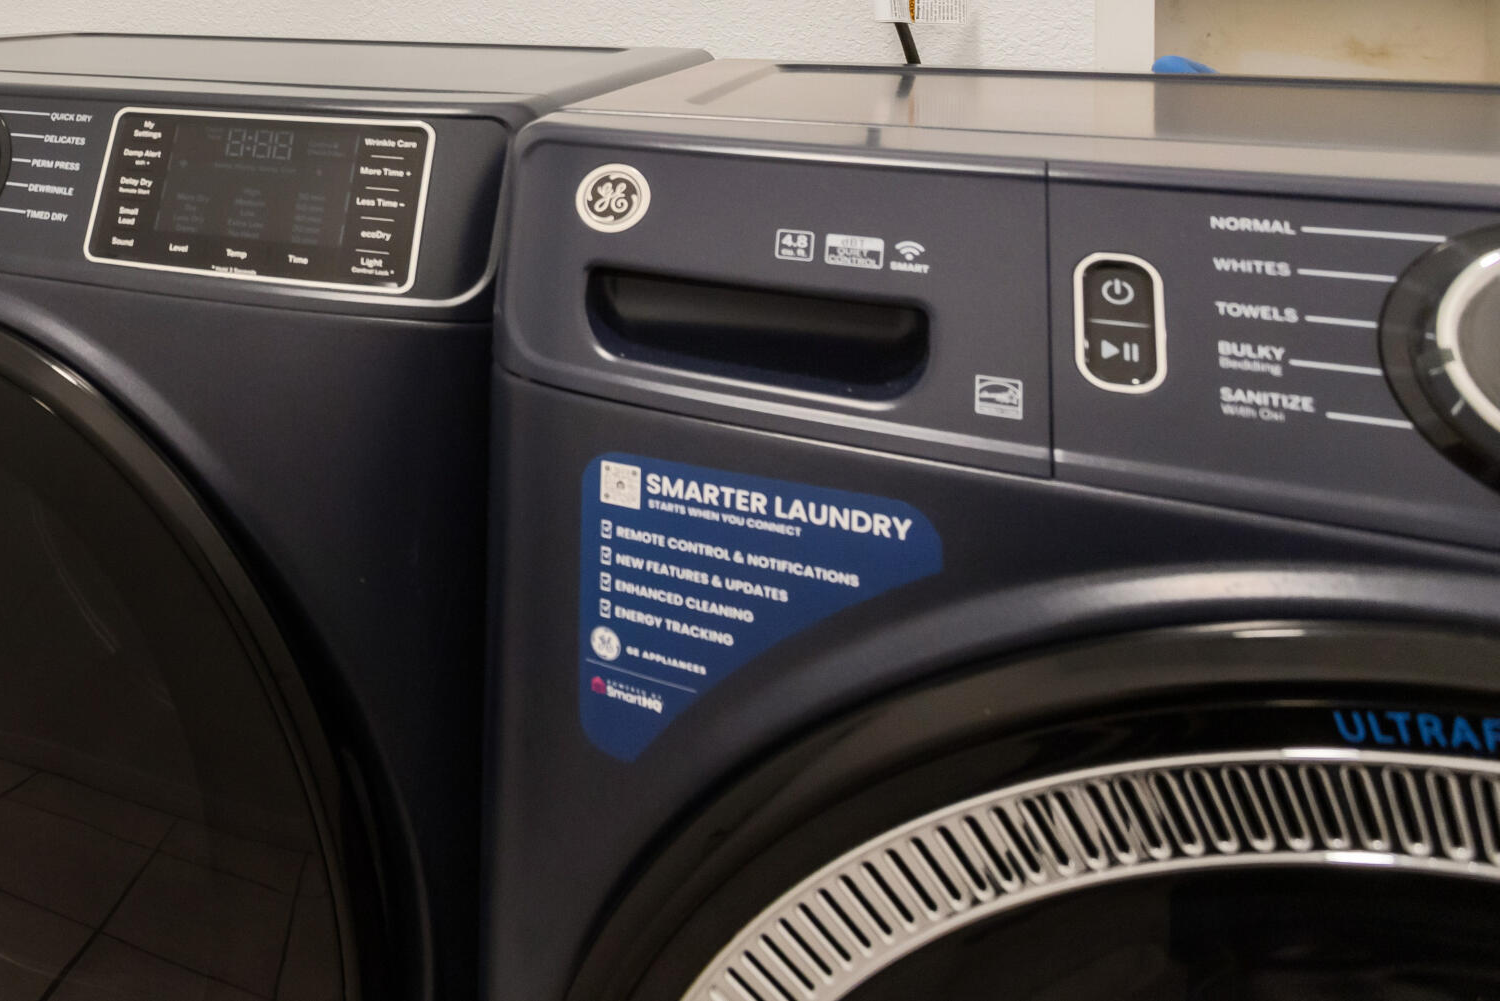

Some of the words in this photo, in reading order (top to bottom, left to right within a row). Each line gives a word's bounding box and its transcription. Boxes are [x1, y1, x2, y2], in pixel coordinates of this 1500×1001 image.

[50, 112, 75, 121] QUICK
[76, 114, 92, 122] DRY
[44, 134, 86, 146] DELICATES
[364, 138, 396, 148] Wrinkle
[397, 139, 417, 148] Care
[32, 158, 54, 168] PERM
[54, 160, 80, 171] PRESS
[360, 166, 382, 176] More
[383, 167, 404, 177] Time
[28, 183, 74, 196] DEWRINKLE
[120, 176, 140, 186] Delay
[140, 178, 153, 188] Dry
[356, 197, 376, 206] Less
[377, 198, 398, 208] Time
[26, 209, 50, 220] TIMED
[50, 212, 68, 222] DRY
[1210, 215, 1297, 236] NORMAL
[360, 230, 392, 242] ecoDry
[781, 234, 808, 248] 4.8
[112, 236, 134, 246] Sound
[169, 243, 189, 253] Level
[226, 248, 248, 260] Temp
[288, 254, 309, 265] Time
[360, 257, 383, 268] Light
[890, 261, 930, 274] SMART
[1212, 256, 1292, 277] WHITES
[1214, 300, 1299, 323] TOWELS
[1218, 340, 1286, 361] BULKY
[1220, 386, 1316, 413] SANITIZE
[646, 474, 768, 516] SMARTER
[774, 496, 913, 541] LAUNDRY
[648, 498, 686, 516] STARTS
[687, 506, 720, 522] WHEN
[722, 513, 746, 527] YOU
[746, 517, 802, 538] CONNECT
[616, 525, 666, 548] REMOTE
[667, 537, 731, 561] CONTROL
[732, 550, 744, 564] &
[746, 553, 860, 588] NOTIFICATIONS
[616, 552, 644, 570] NEW
[646, 560, 709, 586] FEATURES
[710, 574, 722, 588] &
[724, 578, 788, 602] UPDATES
[614, 579, 684, 606] ENHANCED
[685, 596, 754, 624] CLEANING
[614, 606, 662, 629] ENERGY
[664, 618, 735, 647] TRACKING
[642, 650, 707, 676] APPLIANCES
[1332, 710, 1500, 752] ULTRAF
